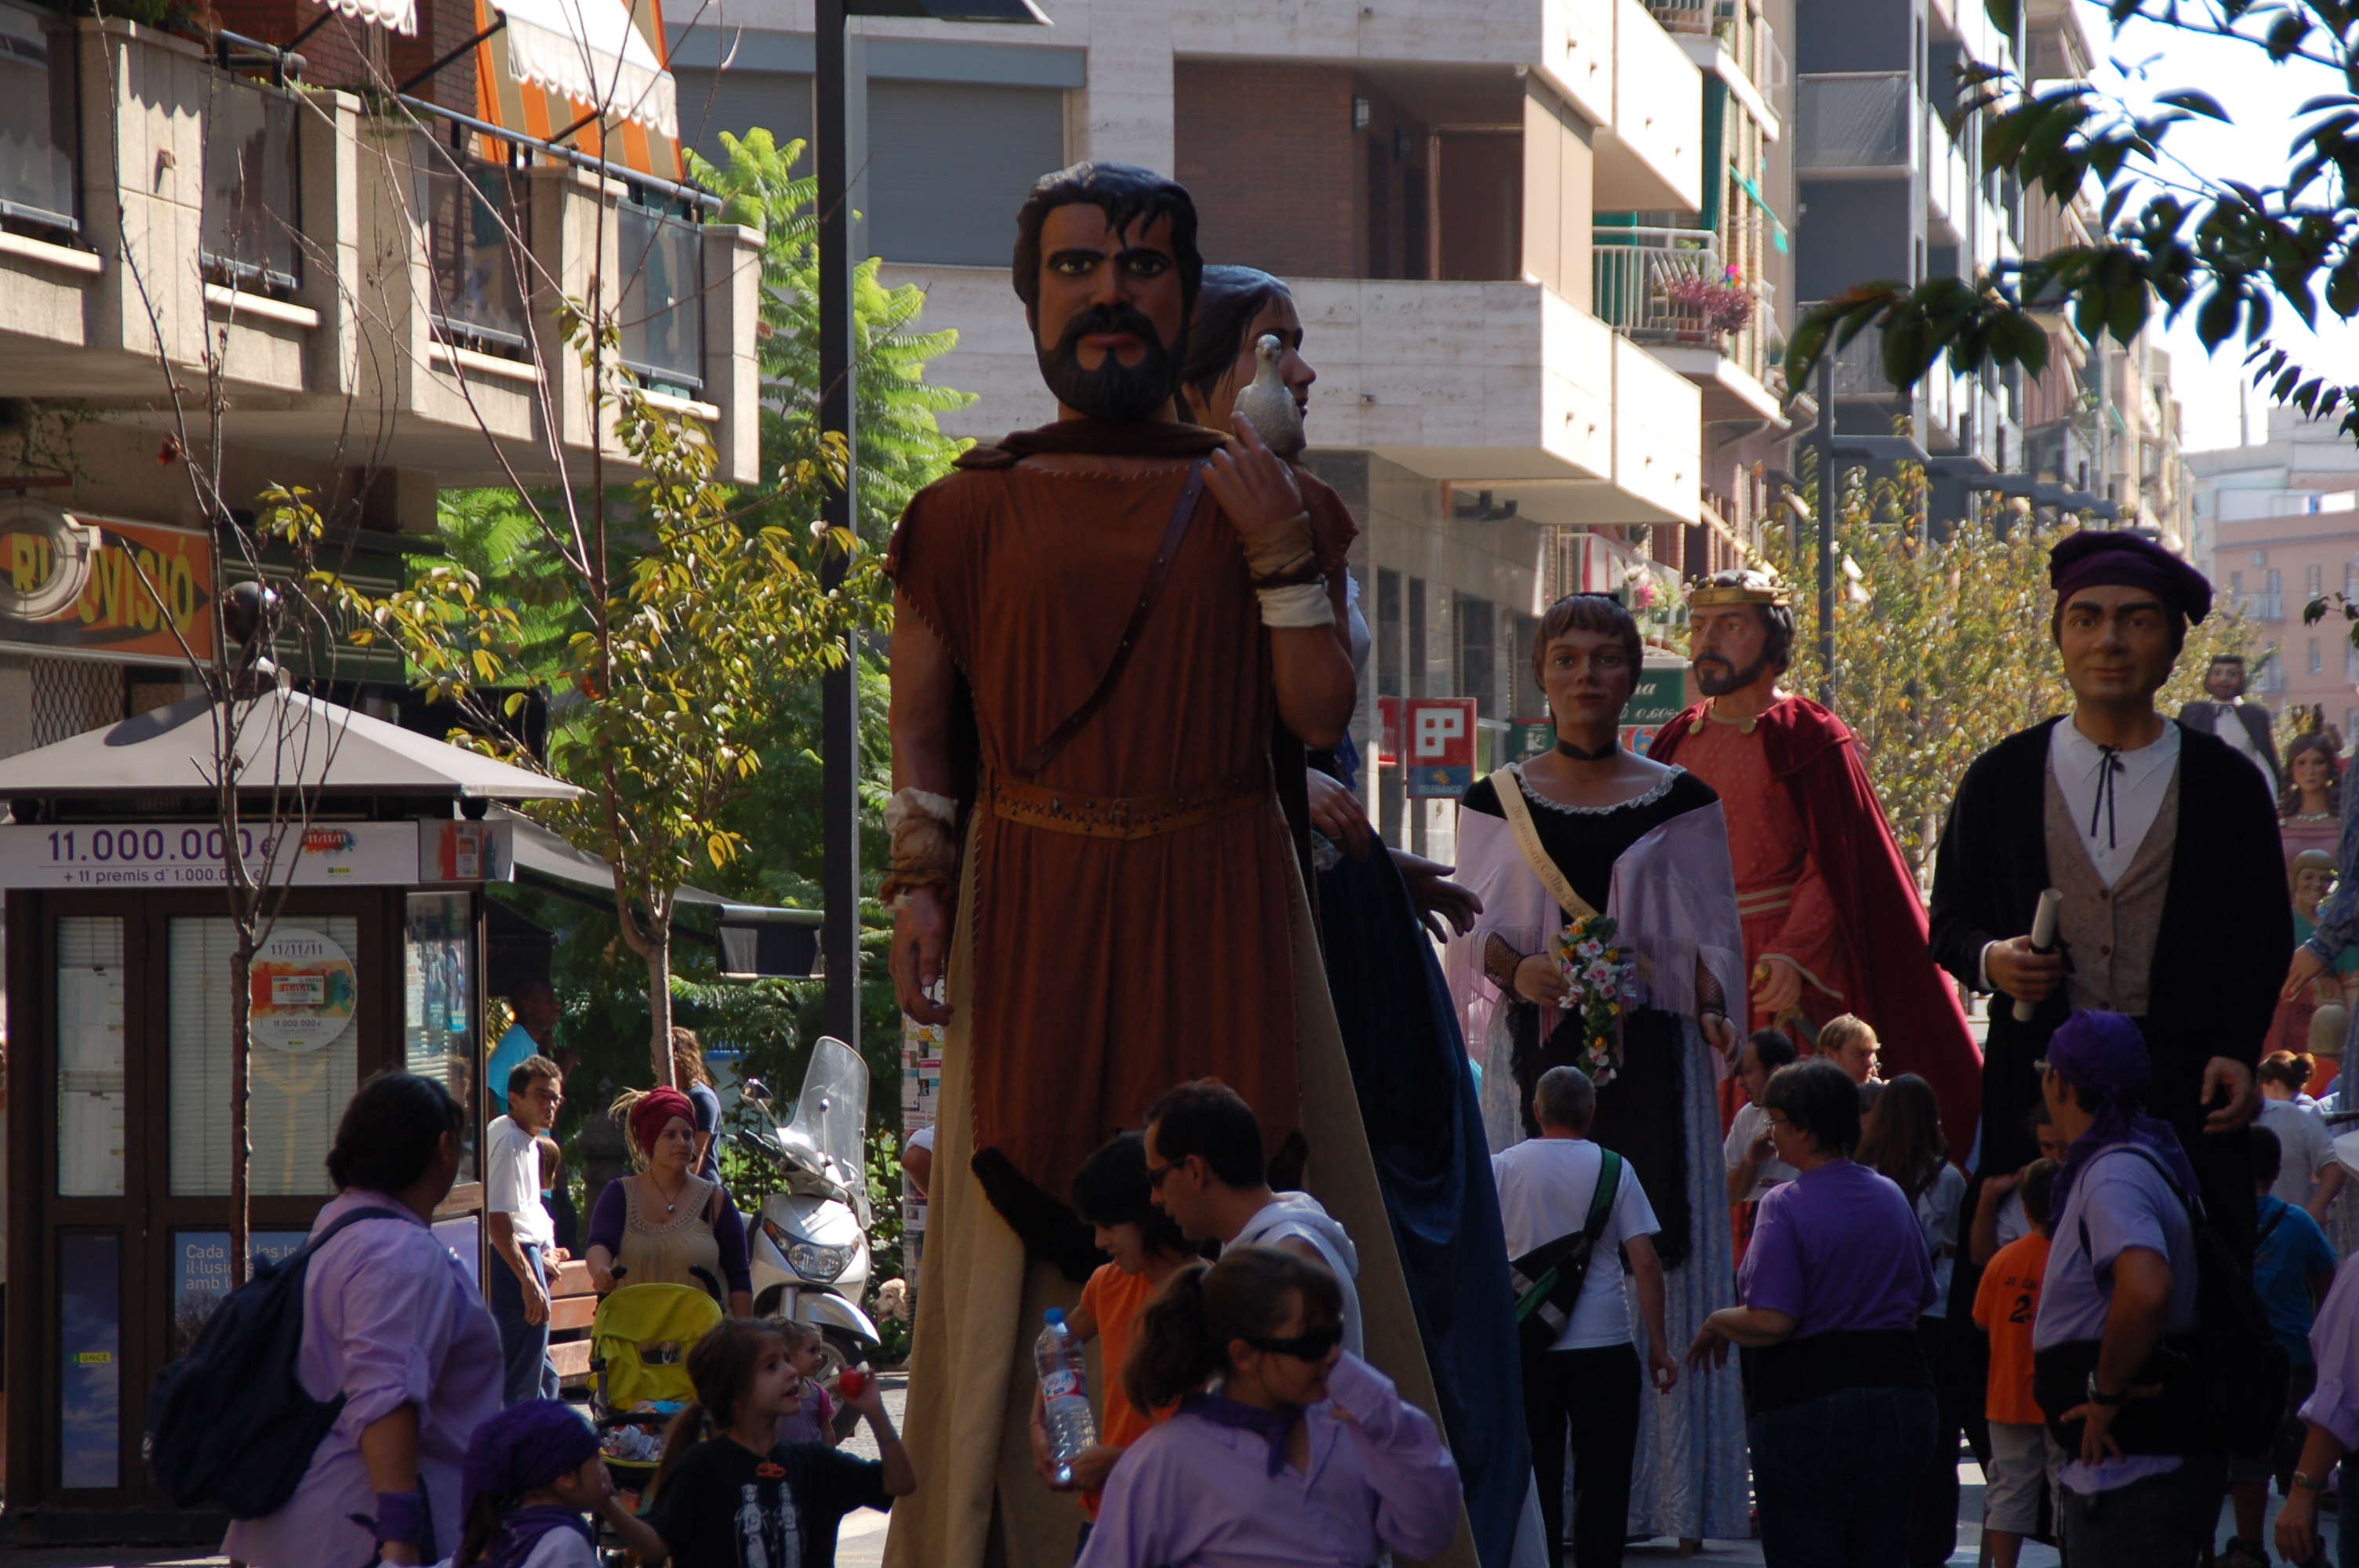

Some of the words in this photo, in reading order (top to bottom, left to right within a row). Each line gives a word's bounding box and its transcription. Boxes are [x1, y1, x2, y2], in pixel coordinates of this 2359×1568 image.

[1419, 785, 1463, 794] TELEBANCO
[96, 868, 149, 884] premis
[271, 943, 322, 955] 11/11/11
[186, 1244, 223, 1259] Cada
[185, 1276, 220, 1290] amb
[82, 1353, 110, 1362] ONCE
